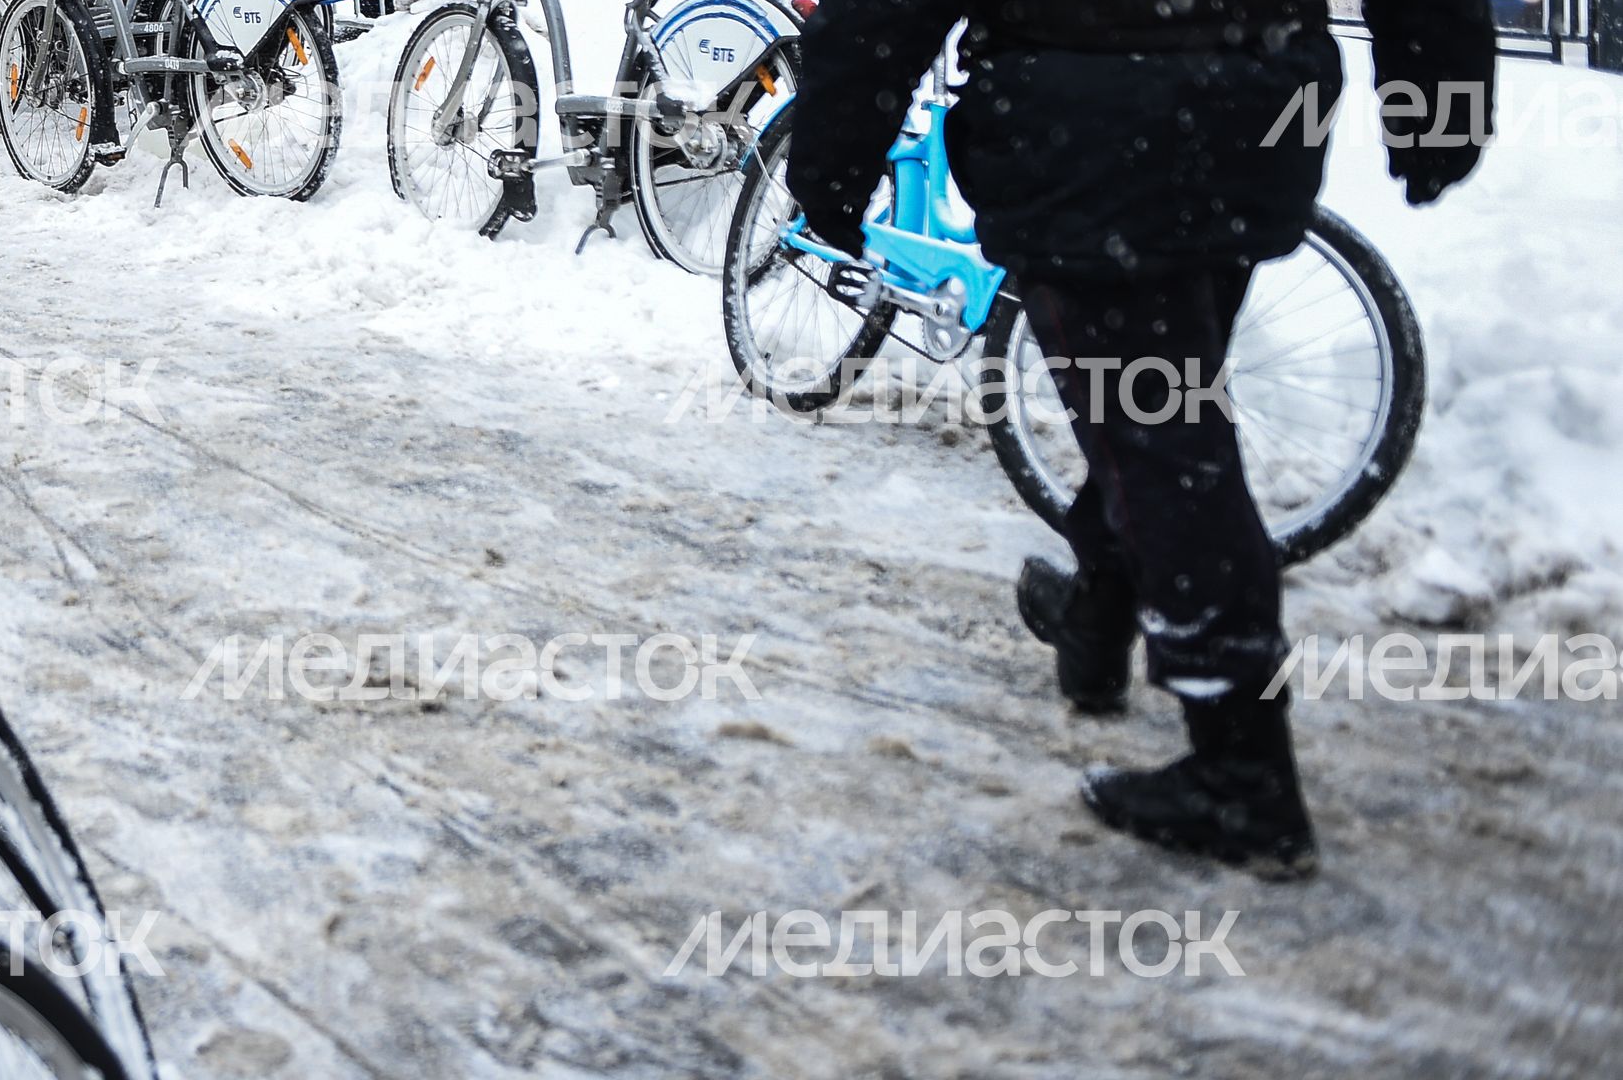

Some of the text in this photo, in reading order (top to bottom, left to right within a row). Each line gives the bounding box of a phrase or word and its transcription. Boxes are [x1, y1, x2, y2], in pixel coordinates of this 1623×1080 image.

[244, 12, 262, 24] ВТБ
[143, 24, 164, 33] 4806
[712, 47, 735, 62] ВТБ
